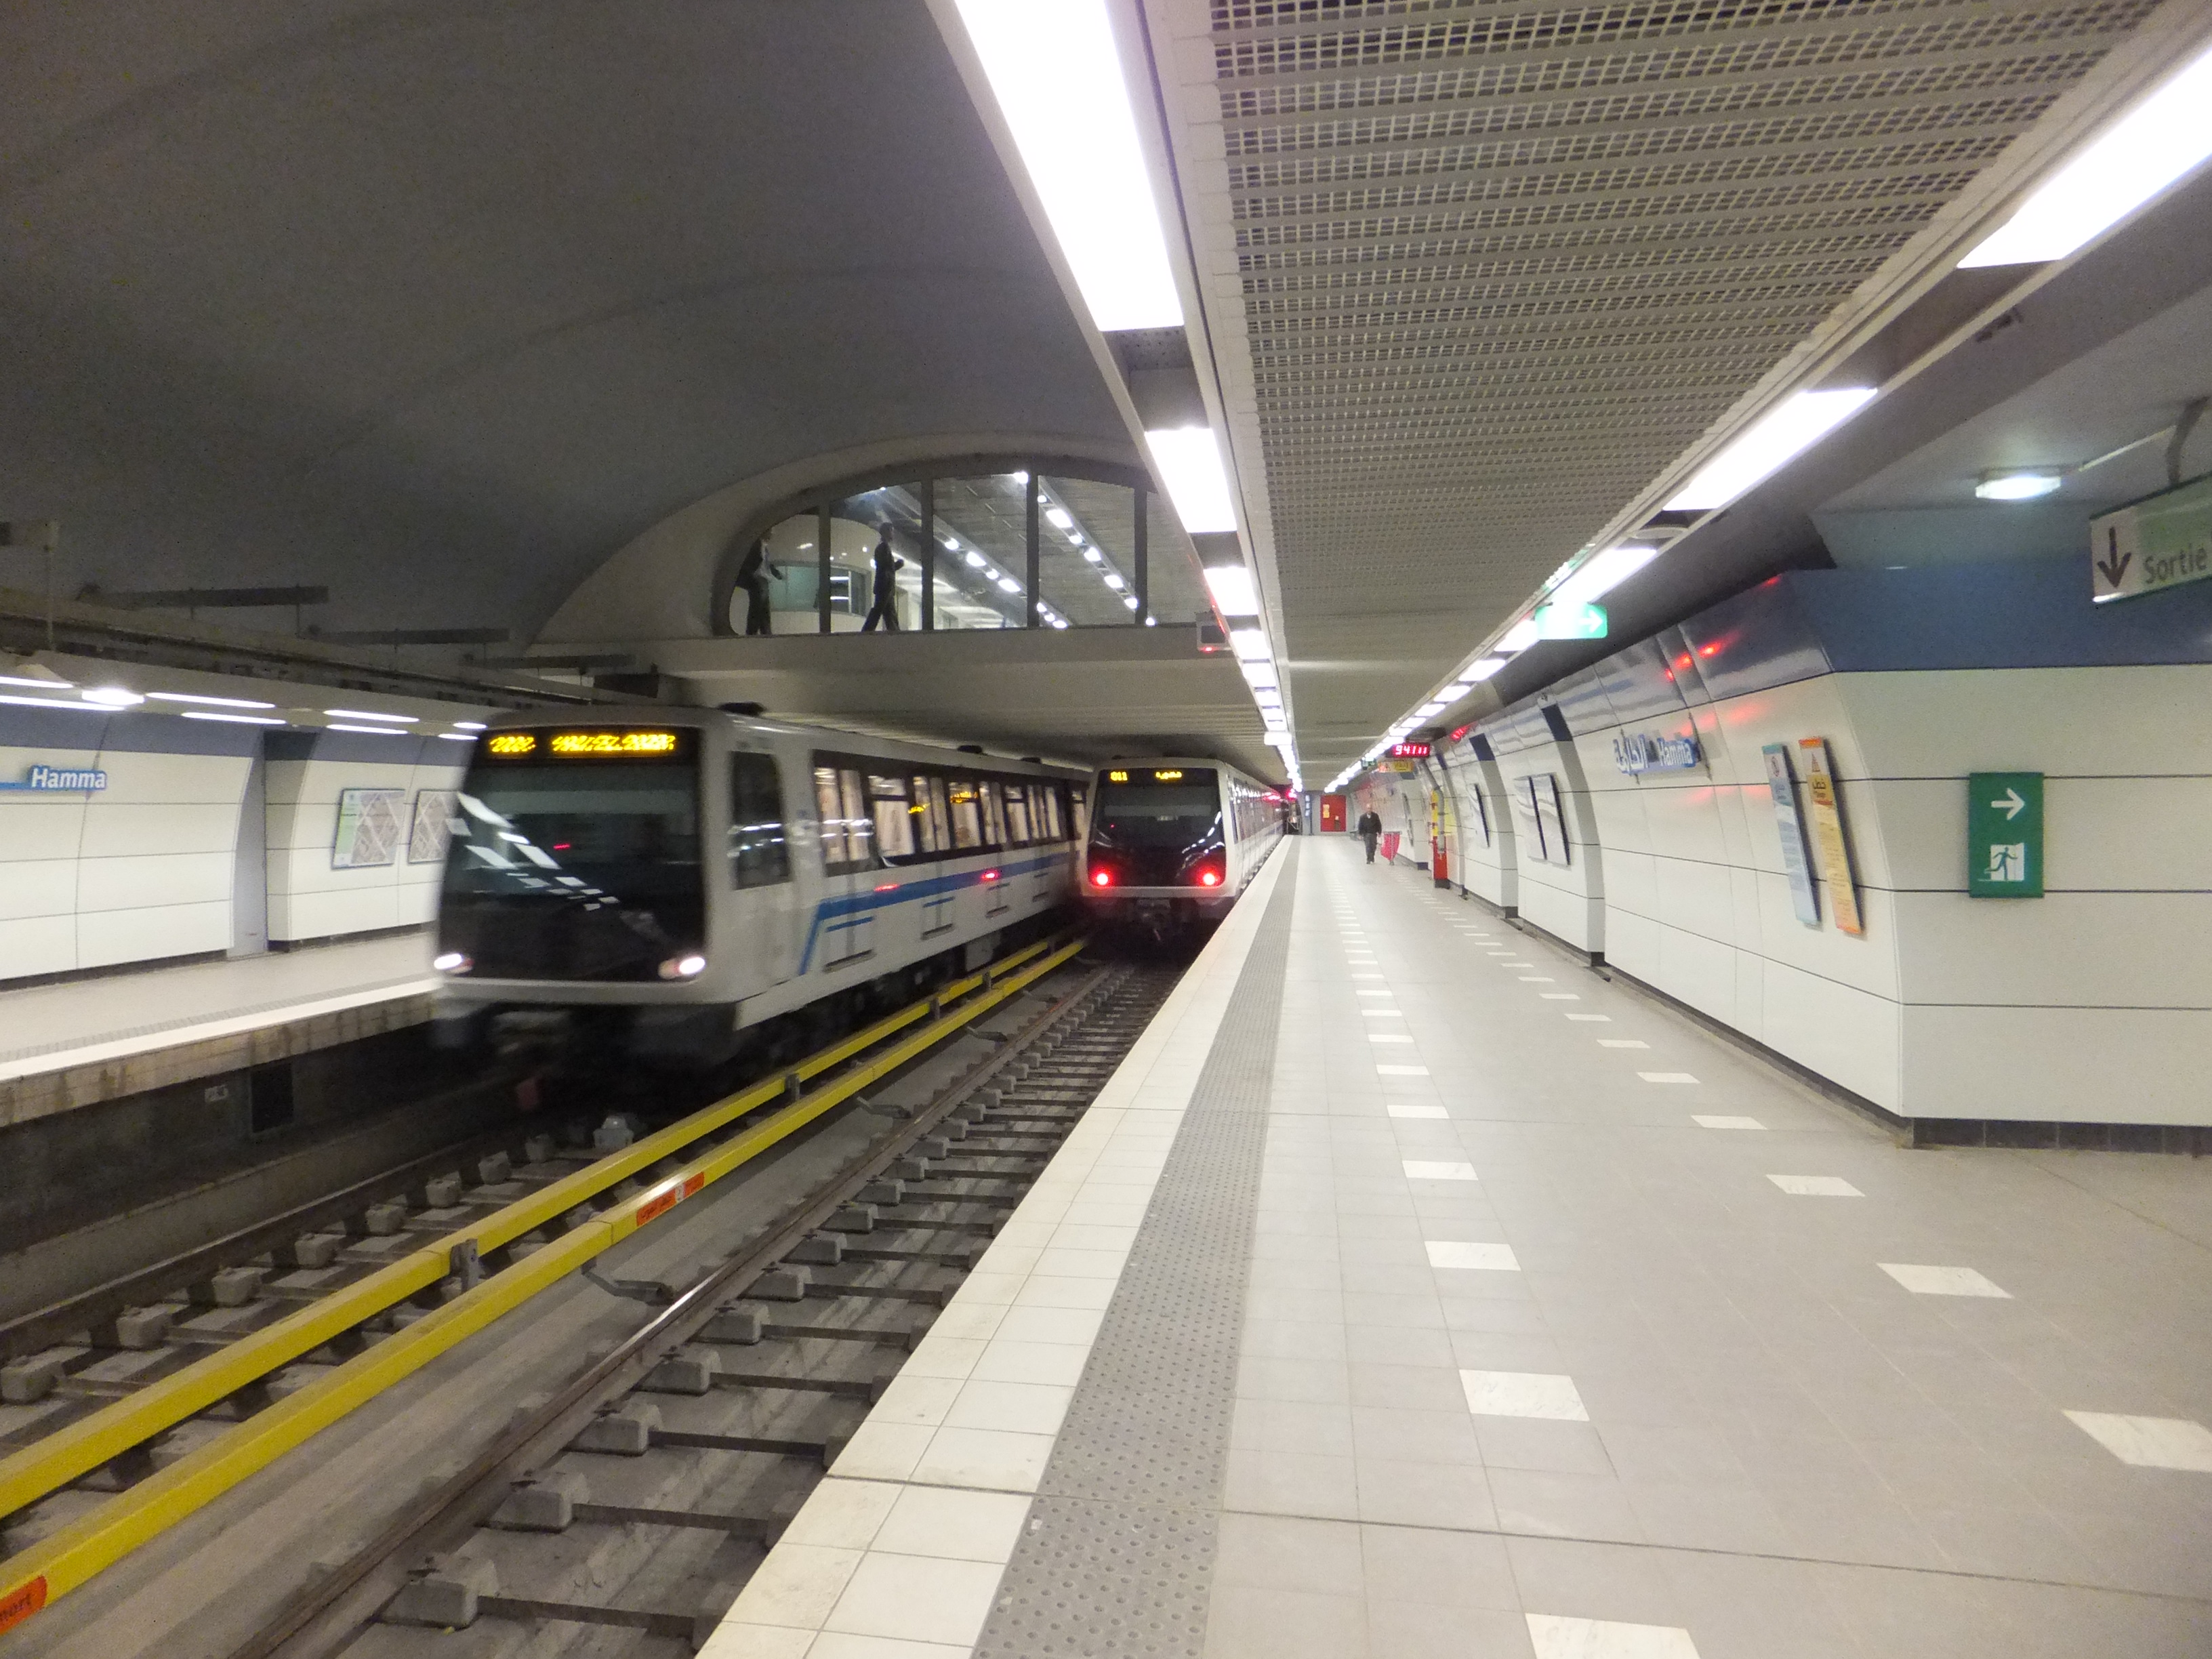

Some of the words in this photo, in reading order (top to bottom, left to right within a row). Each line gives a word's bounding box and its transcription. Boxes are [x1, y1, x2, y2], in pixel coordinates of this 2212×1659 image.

[2142, 541, 2208, 585] Sortie
[1659, 740, 1694, 767] Hamma
[31, 766, 106, 788] Hamma
